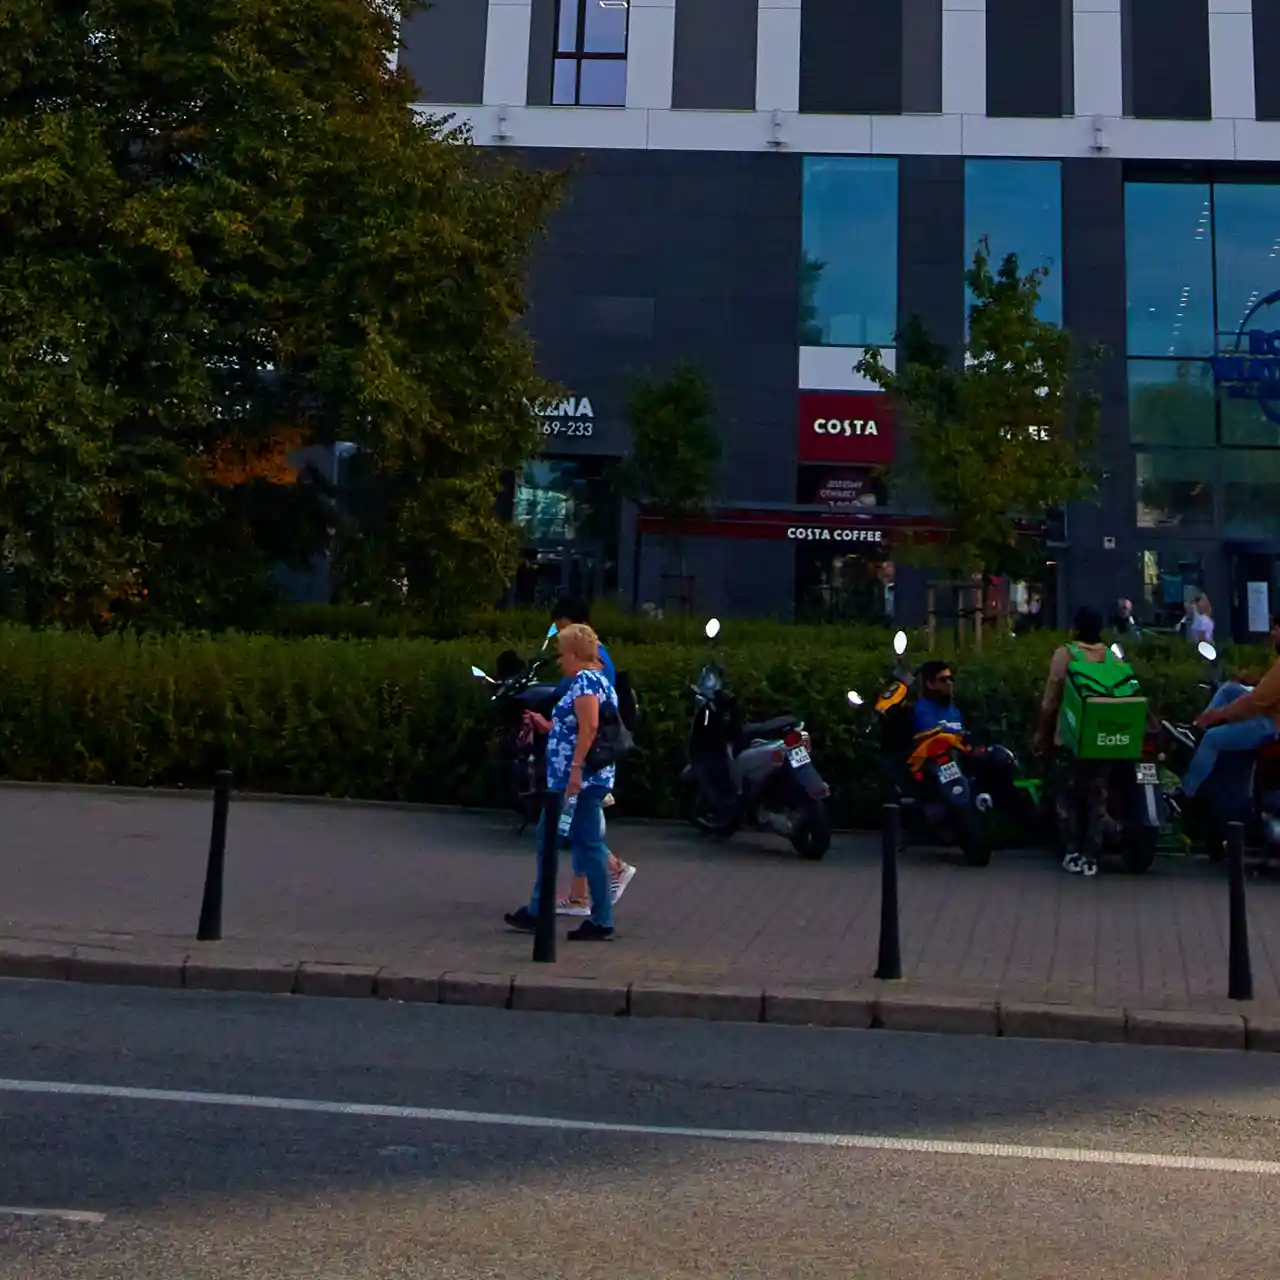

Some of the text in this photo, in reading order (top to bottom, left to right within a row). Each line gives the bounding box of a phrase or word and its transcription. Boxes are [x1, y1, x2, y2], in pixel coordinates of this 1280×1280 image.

[813, 417, 880, 438] COSTA
[787, 526, 883, 544] COSTA COFFEE
[1096, 733, 1131, 746] Eats
